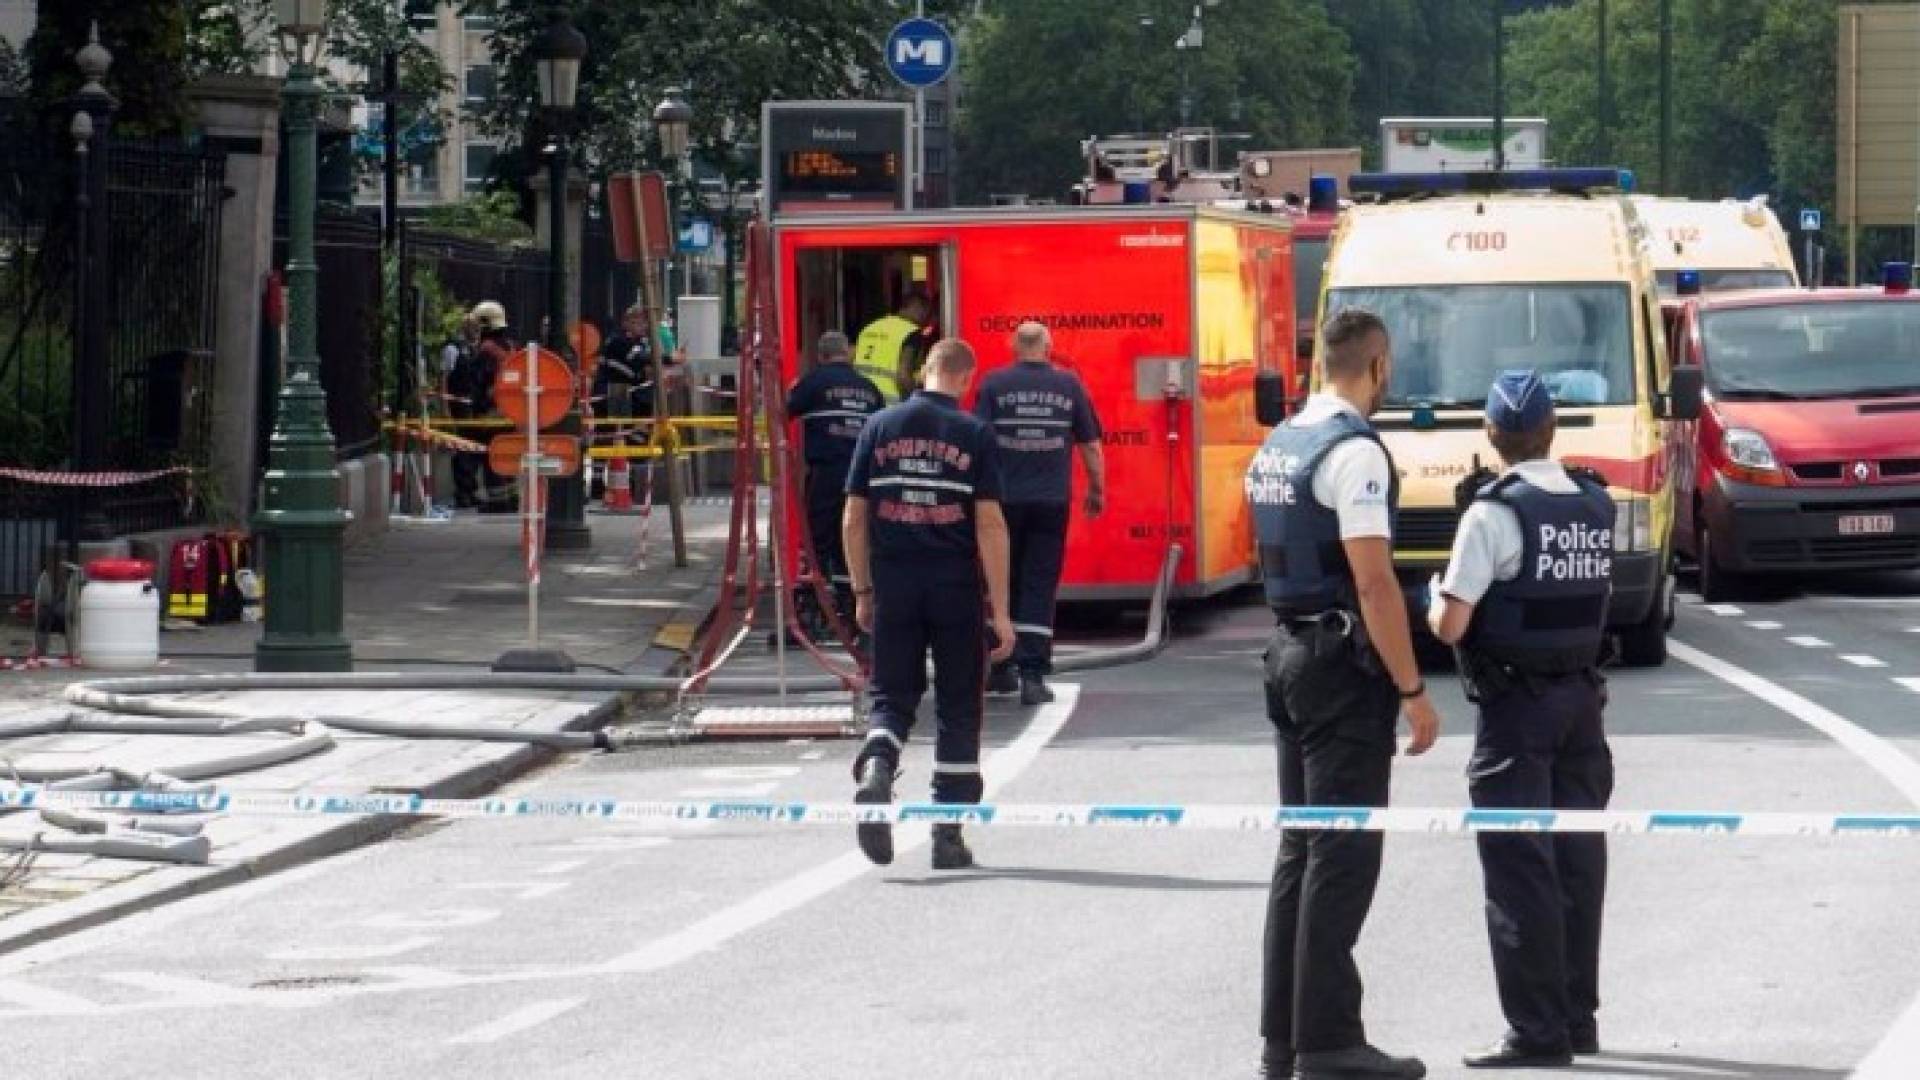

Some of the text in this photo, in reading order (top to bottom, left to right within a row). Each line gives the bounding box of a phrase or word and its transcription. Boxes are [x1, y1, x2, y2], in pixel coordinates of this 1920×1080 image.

[896, 38, 942, 65] M
[1540, 522, 1611, 551] Police
[1536, 552, 1611, 580] Politie
